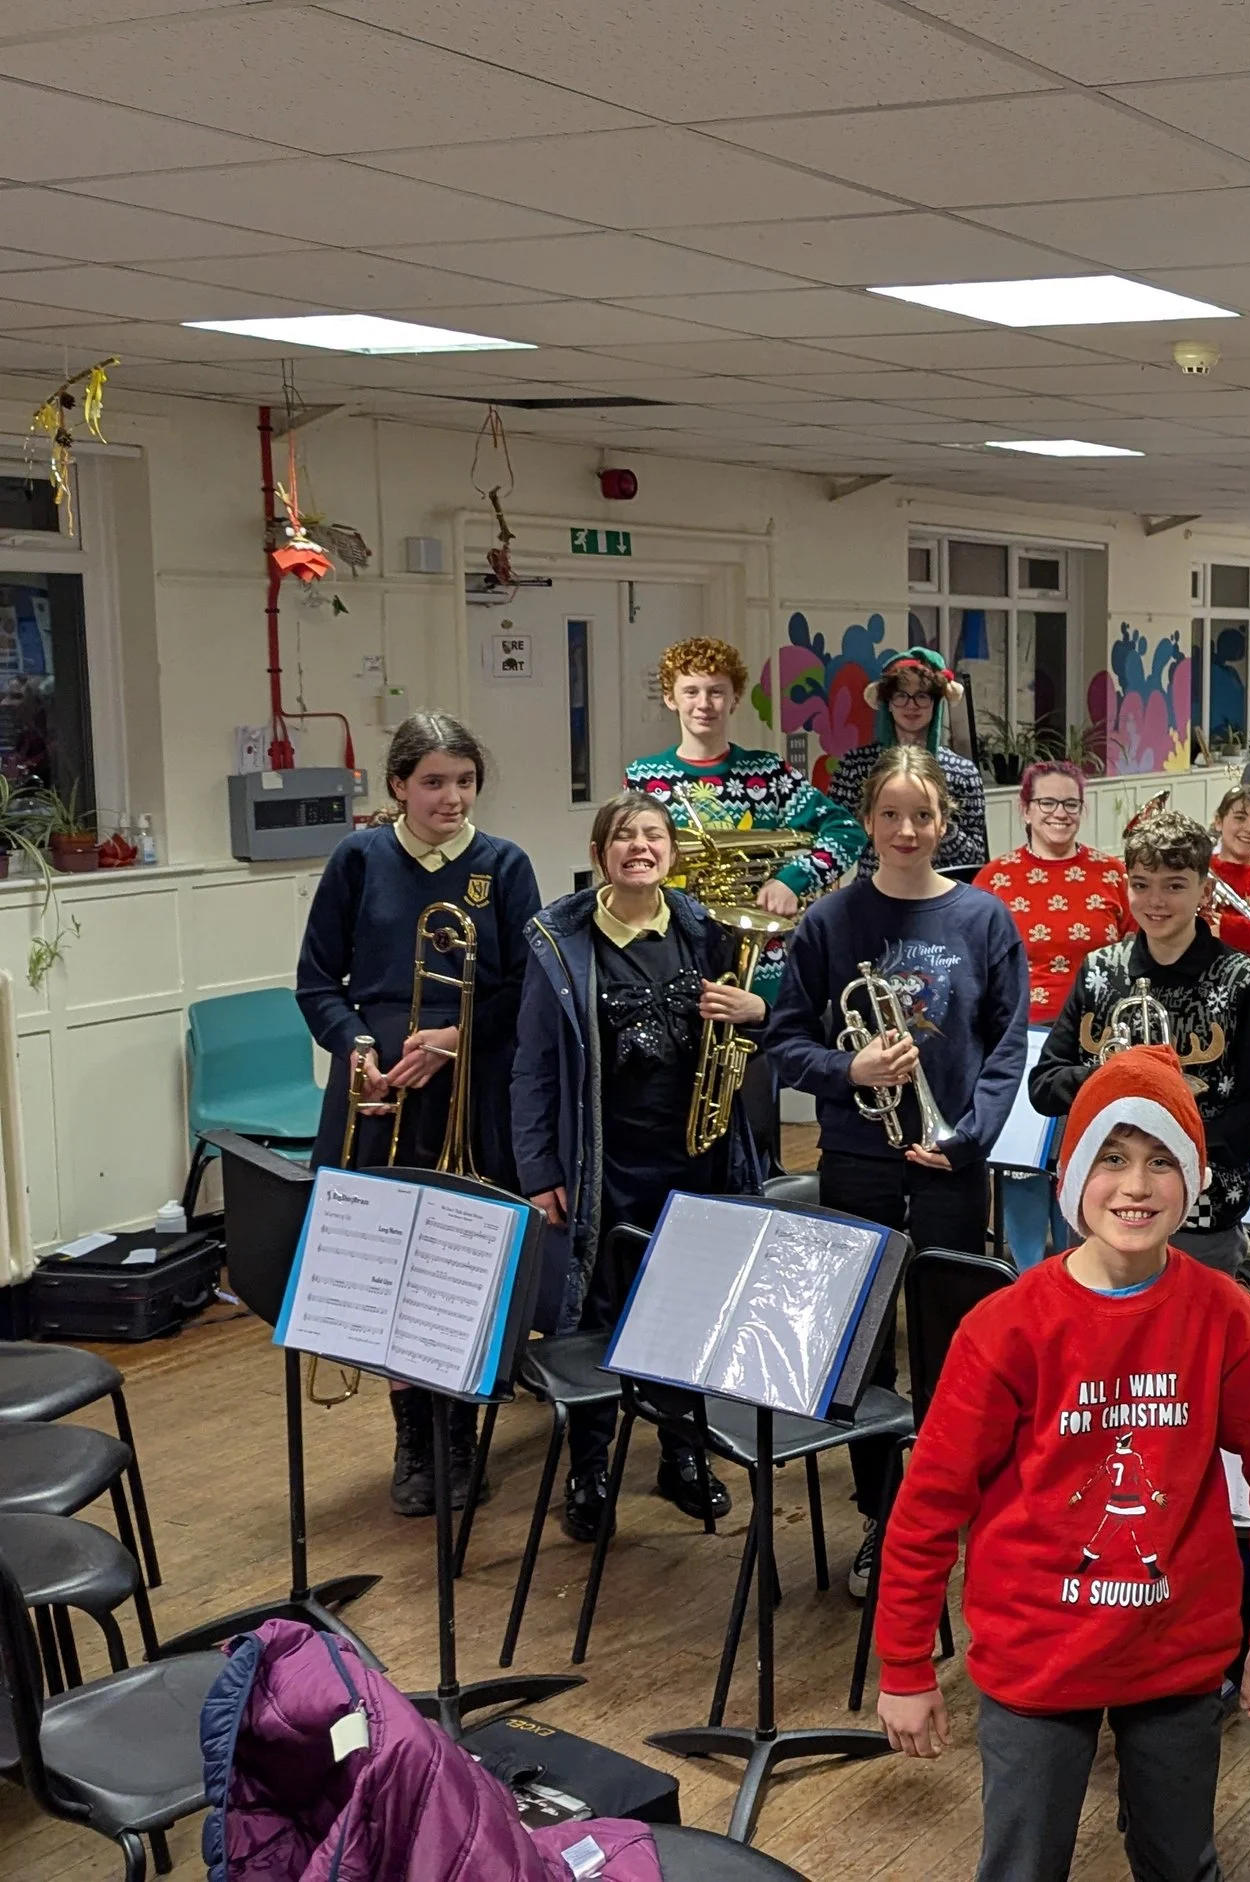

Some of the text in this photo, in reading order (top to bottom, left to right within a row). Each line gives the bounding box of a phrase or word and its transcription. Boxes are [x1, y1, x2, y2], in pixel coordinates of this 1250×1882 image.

[905, 944, 946, 960] Winter
[926, 954, 962, 968] Magic
[1079, 1373, 1178, 1405] ALL I WANT
[1059, 1402, 1190, 1436] FOR CHRISTMAS
[1112, 1462, 1124, 1487] 7
[1061, 1577, 1080, 1604] IS
